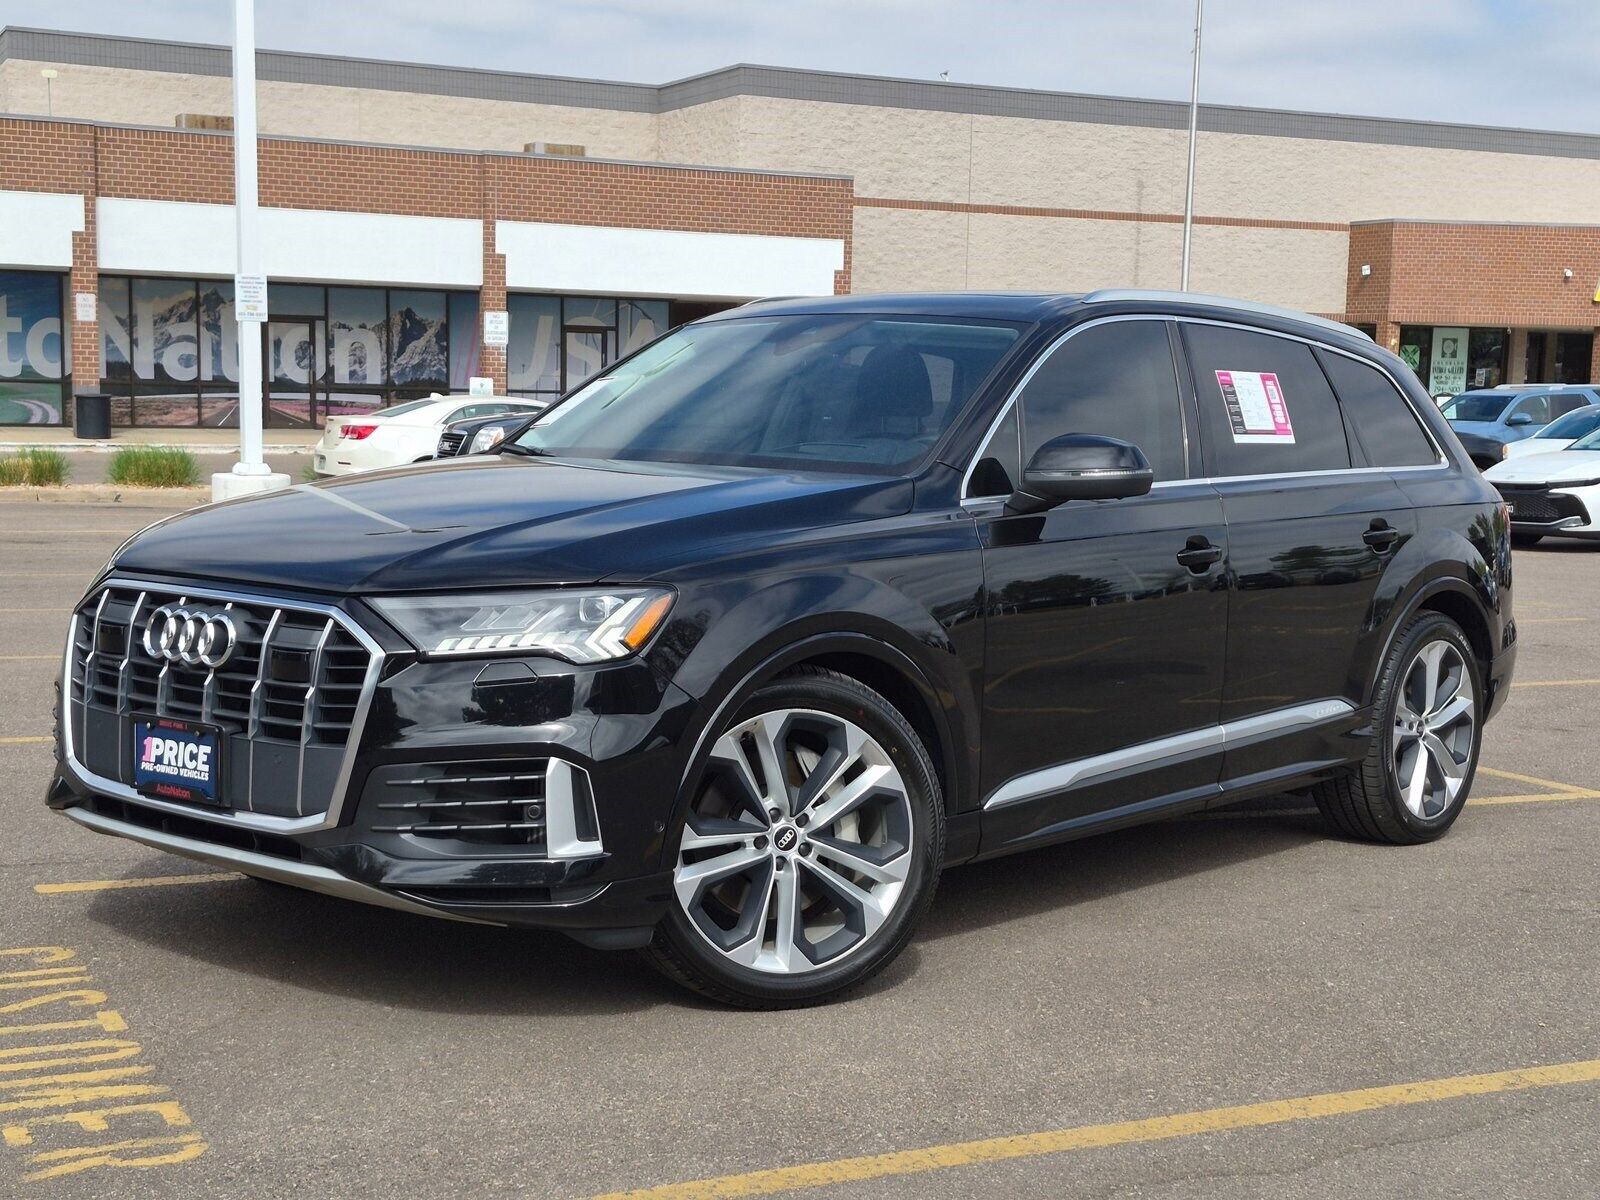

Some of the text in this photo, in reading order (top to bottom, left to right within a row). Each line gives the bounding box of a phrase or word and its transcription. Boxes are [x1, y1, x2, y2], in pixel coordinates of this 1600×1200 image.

[142, 736, 212, 772] 1PRICE
[141, 761, 210, 781] PRE-OWNED VEHICLES
[156, 784, 191, 799] AutoNation
